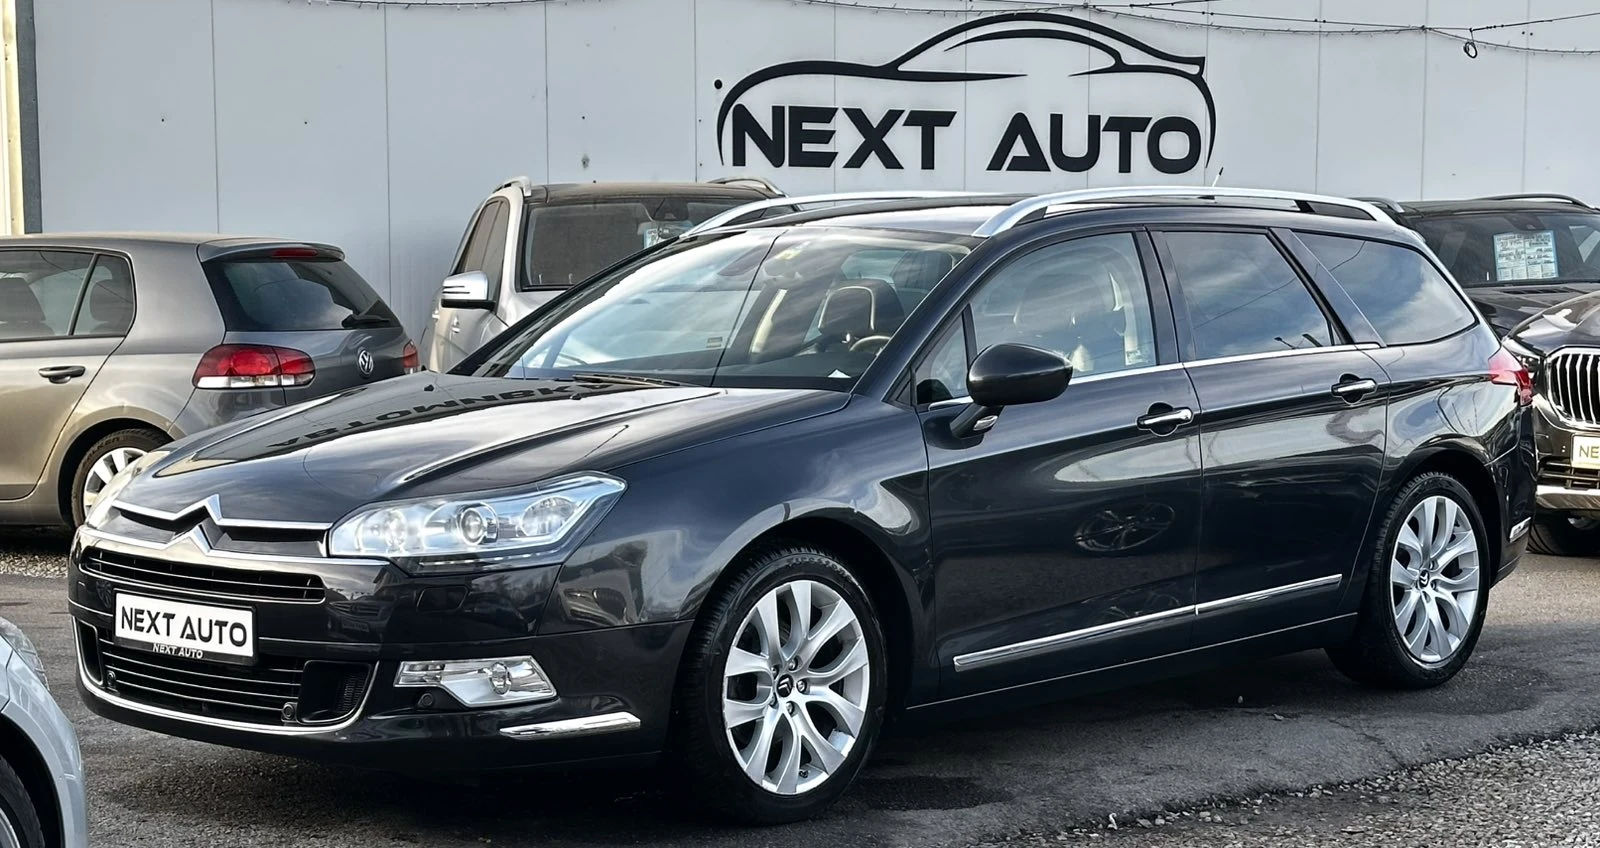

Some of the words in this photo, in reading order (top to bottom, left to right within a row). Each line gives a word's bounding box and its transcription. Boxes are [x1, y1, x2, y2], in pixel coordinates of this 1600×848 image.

[732, 104, 957, 170] NEXT
[986, 112, 1201, 174] AUTO
[121, 606, 176, 637] NEXT
[180, 615, 247, 647] AUTO
[152, 643, 177, 656] NEXT
[178, 647, 204, 659] AUTO
